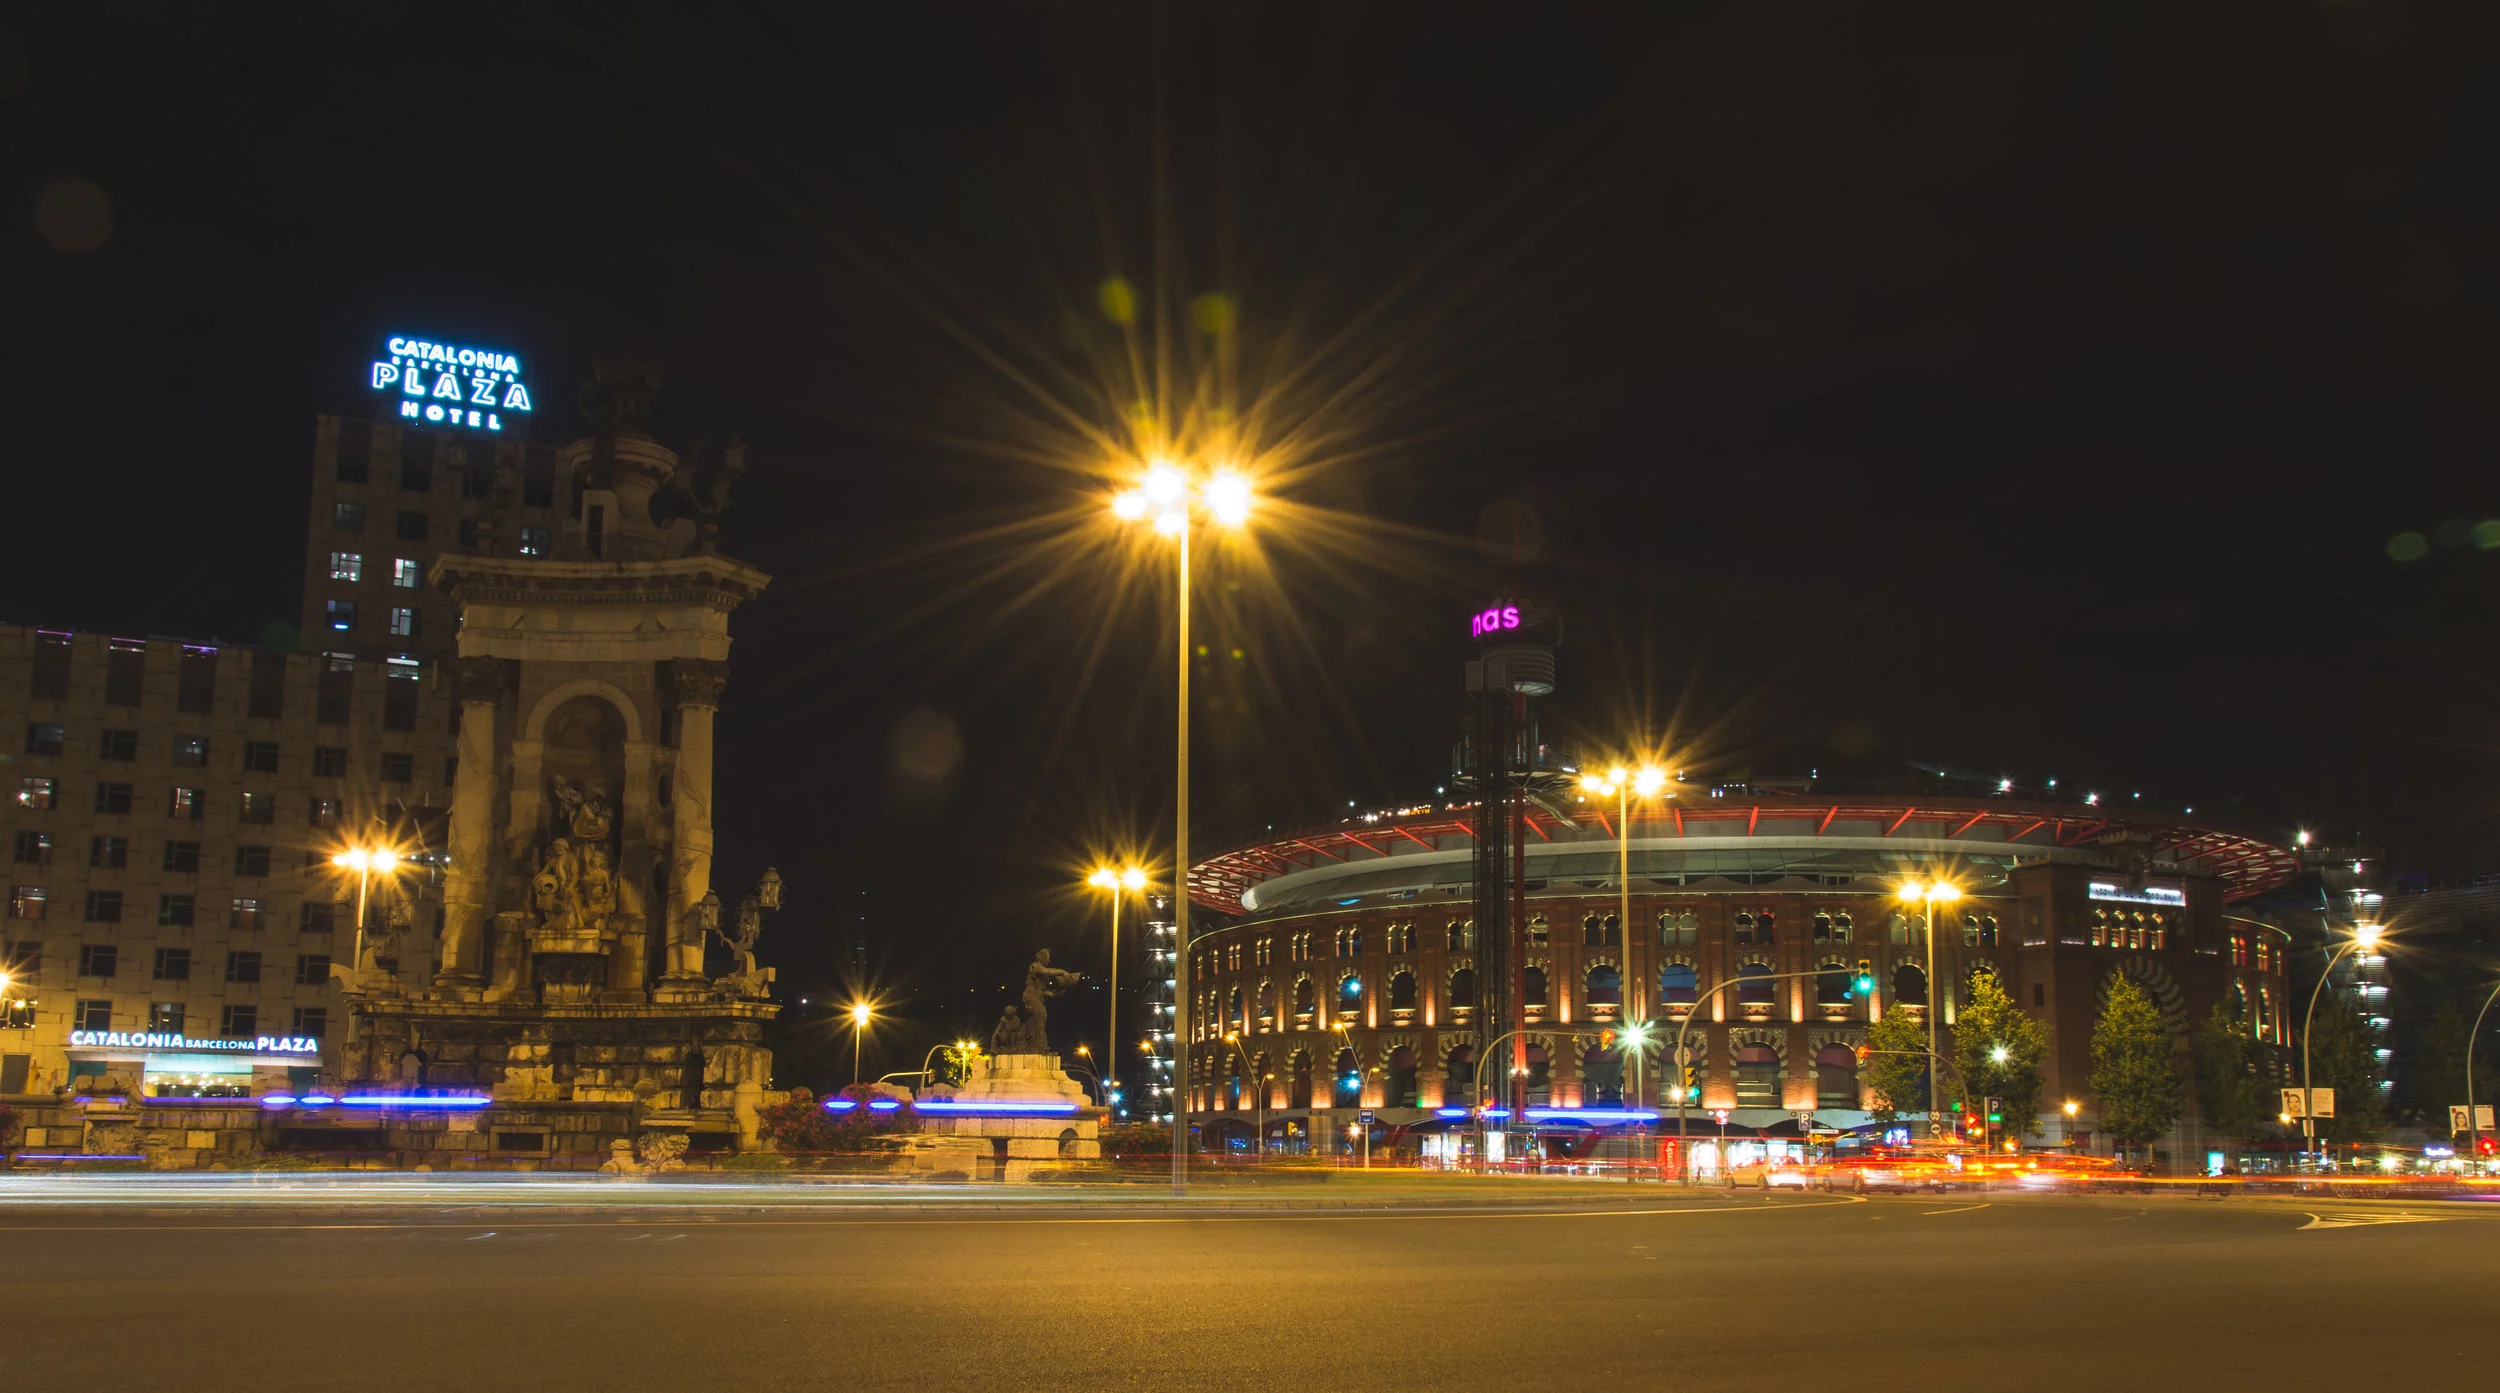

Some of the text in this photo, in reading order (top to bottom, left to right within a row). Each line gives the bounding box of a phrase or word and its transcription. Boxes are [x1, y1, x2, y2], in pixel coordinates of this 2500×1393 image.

[389, 337, 519, 374] CATALONIA
[391, 356, 515, 383] BARCELONA
[372, 361, 532, 411] PLAZA
[401, 401, 502, 430] HOTEL
[1472, 606, 1520, 637] nas
[70, 1031, 318, 1052] CATALONIA BARCELONA PLAZA
[1991, 1100, 1999, 1112] P
